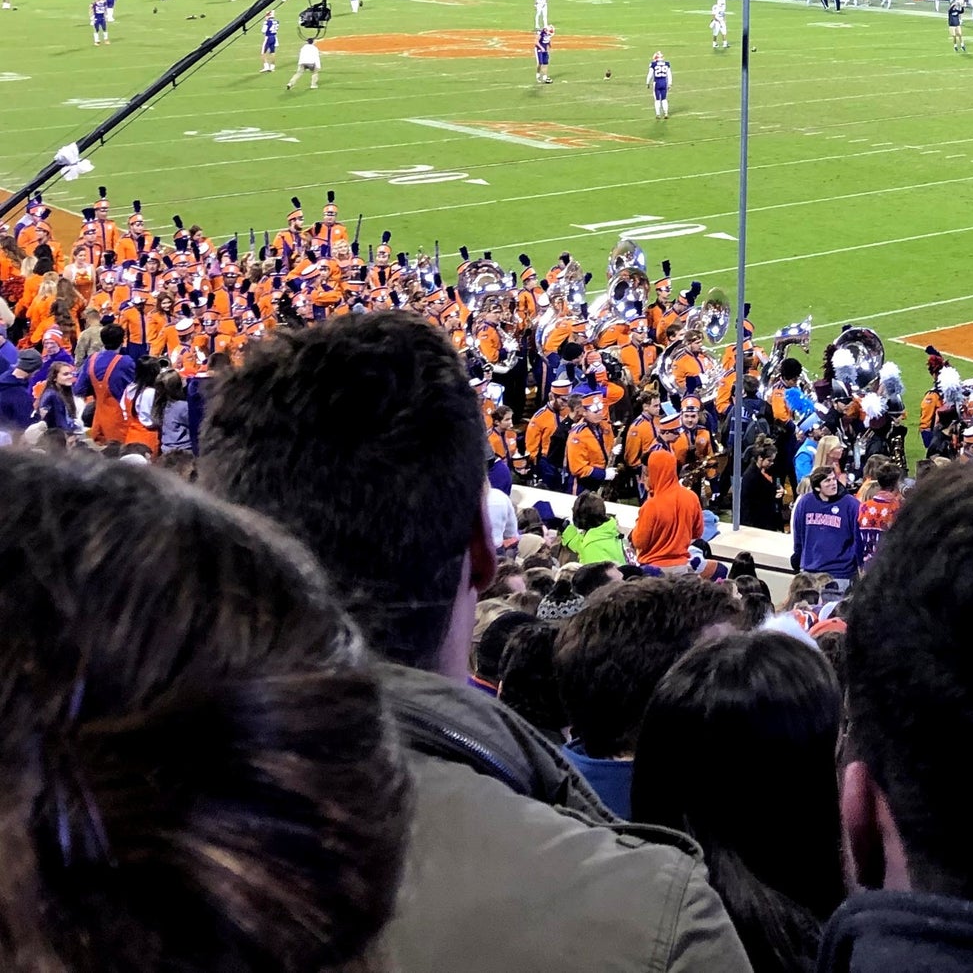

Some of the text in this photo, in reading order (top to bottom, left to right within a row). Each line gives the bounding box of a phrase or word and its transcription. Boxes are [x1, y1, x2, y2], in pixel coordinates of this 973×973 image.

[654, 65, 668, 77] 29
[570, 214, 708, 240] 10
[805, 512, 842, 529] CLEMSON
